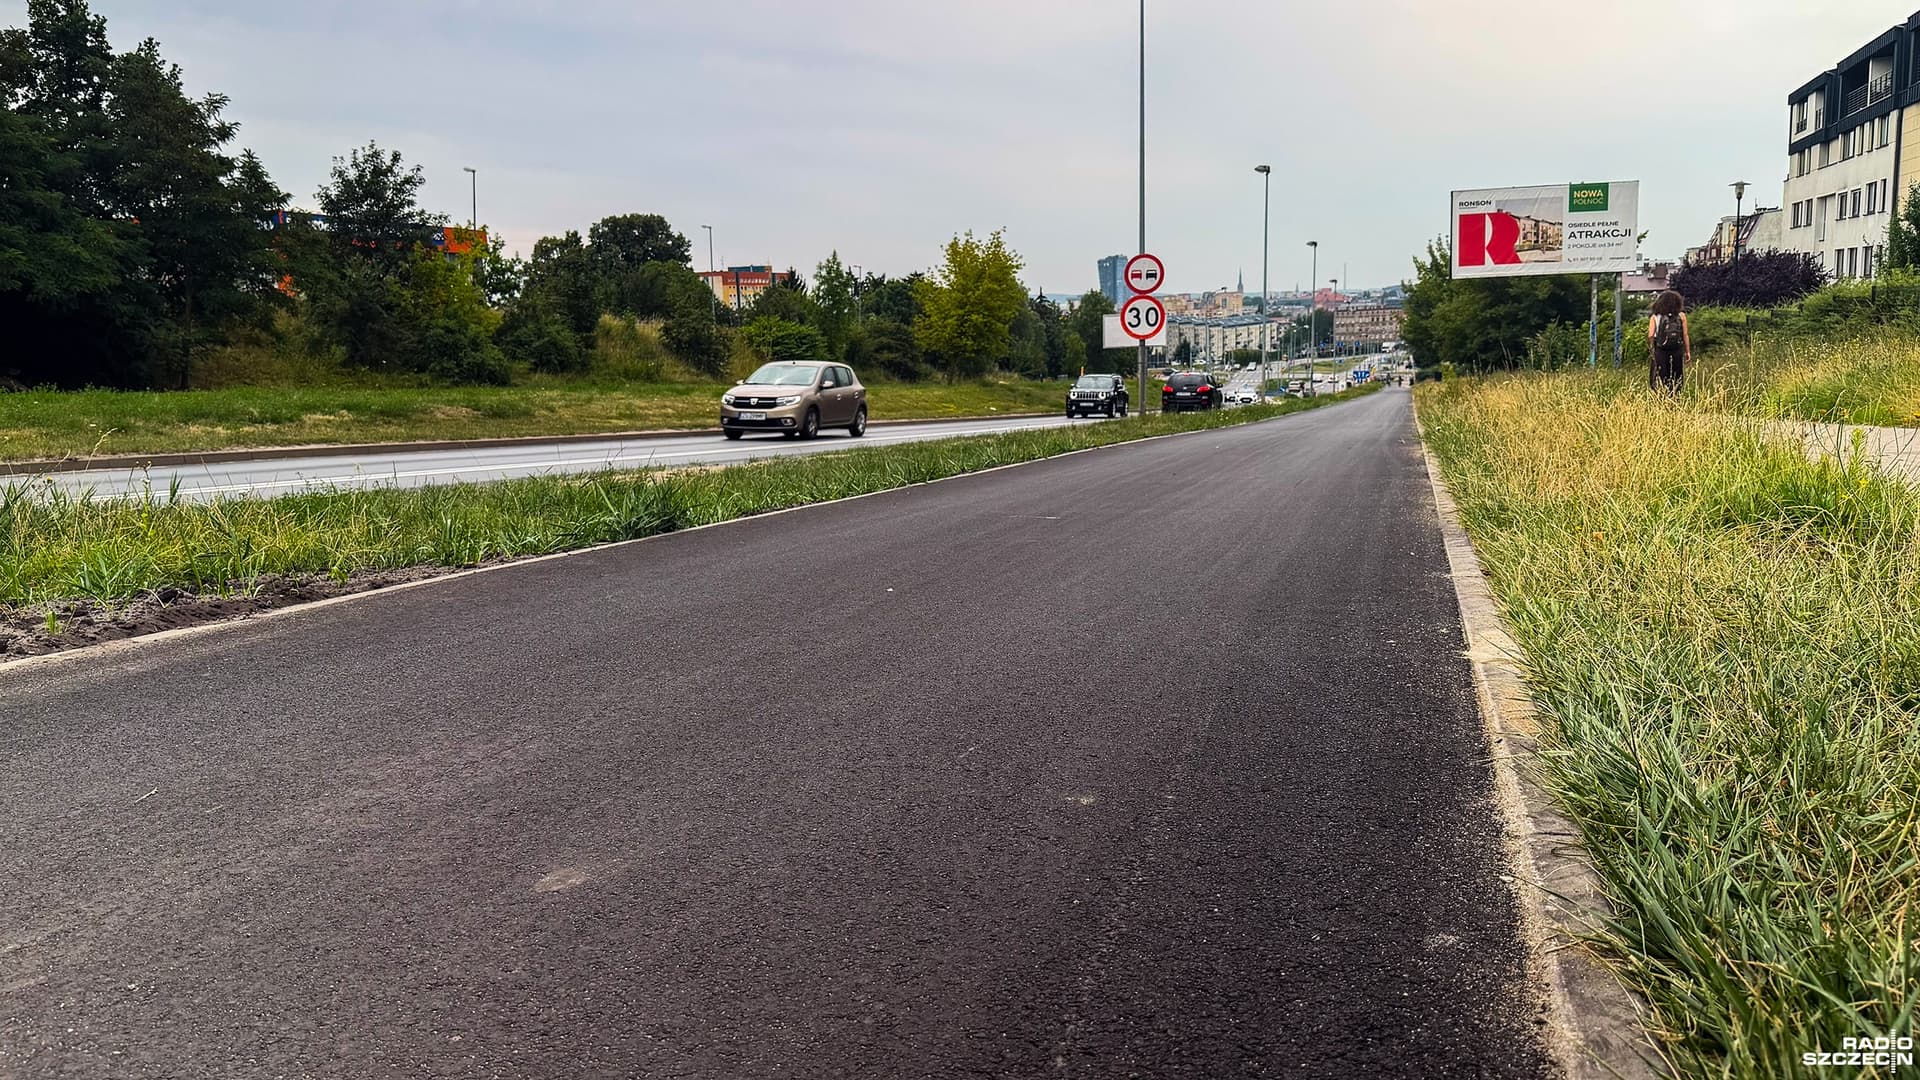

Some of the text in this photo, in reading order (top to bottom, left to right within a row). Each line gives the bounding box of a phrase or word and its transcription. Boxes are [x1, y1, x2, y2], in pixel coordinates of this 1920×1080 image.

[1573, 189, 1604, 198] NOWA
[1568, 228, 1631, 240] ATRAKCJI
[1127, 307, 1159, 328] 30
